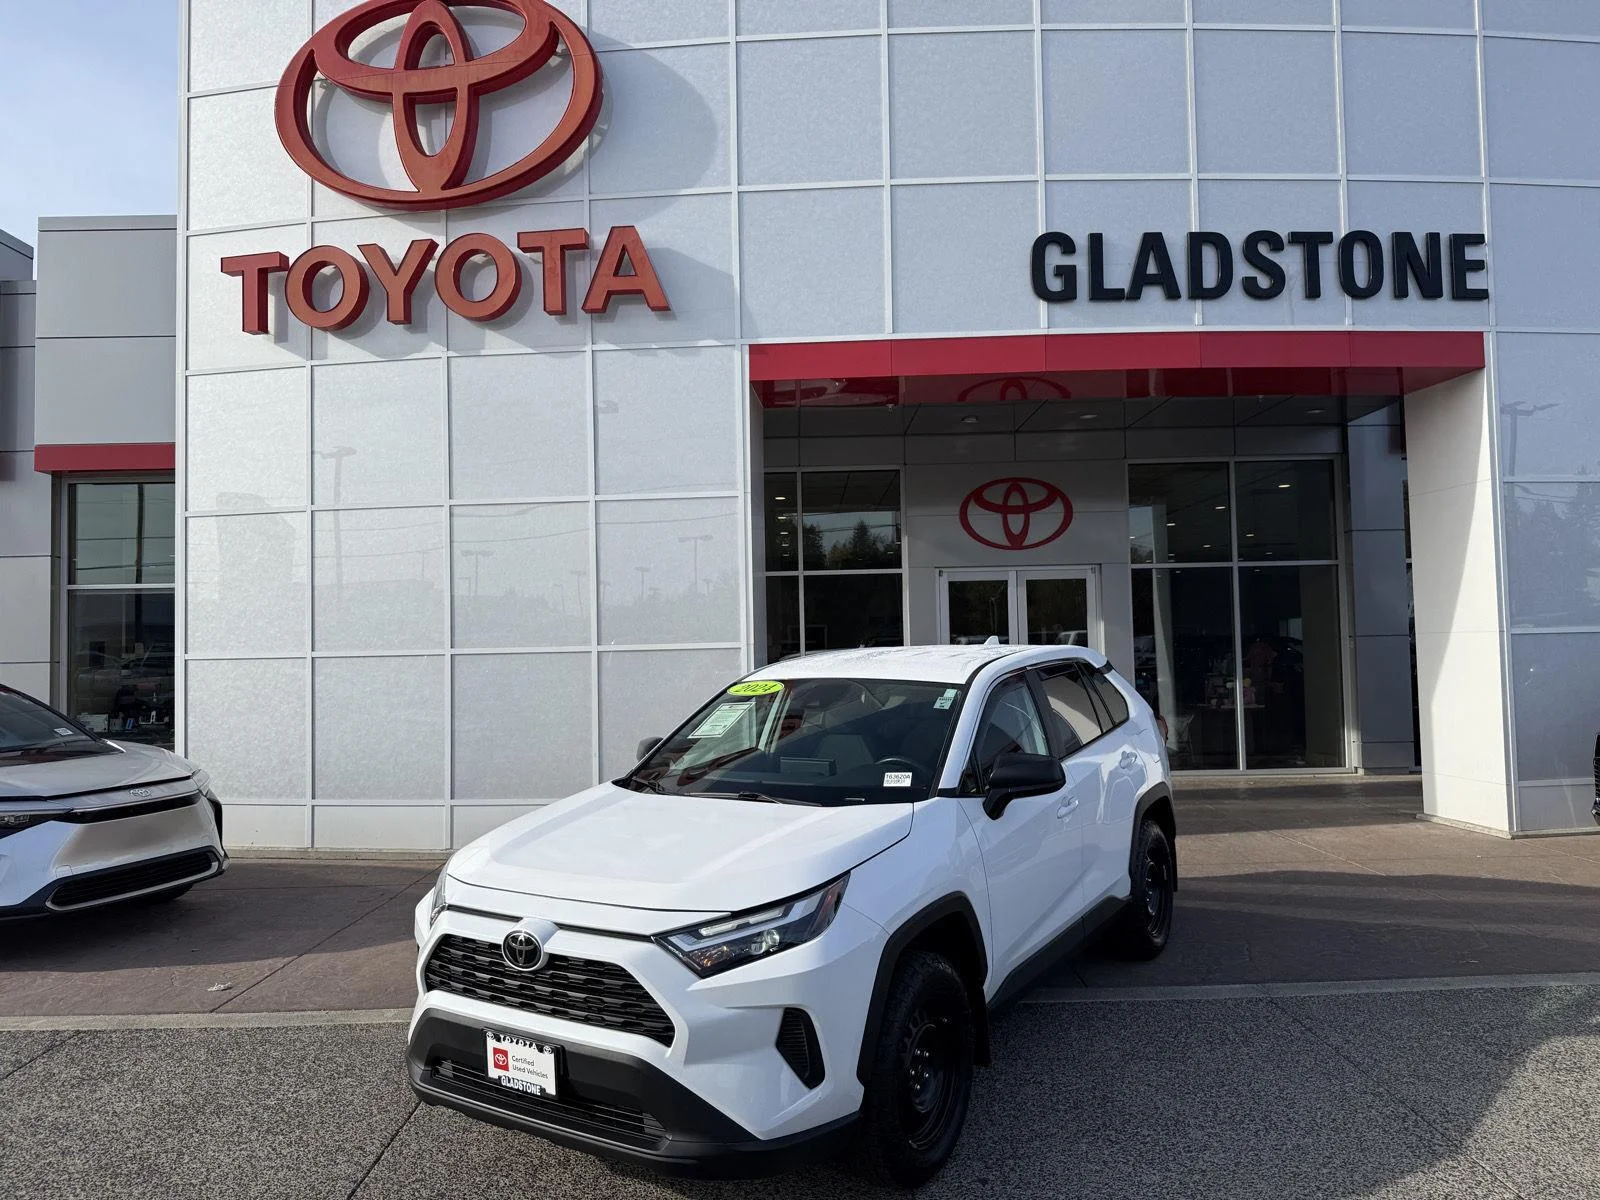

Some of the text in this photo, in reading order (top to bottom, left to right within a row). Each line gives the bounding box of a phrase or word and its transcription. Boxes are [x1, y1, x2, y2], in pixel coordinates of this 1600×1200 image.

[1030, 230, 1490, 302] GLADSTONE
[221, 225, 670, 335] TOYOTA
[733, 684, 778, 693] 2024
[511, 1055, 535, 1067] Certified
[512, 1064, 549, 1080] Used Vehicles
[501, 1075, 541, 1096] GLADSTONE
